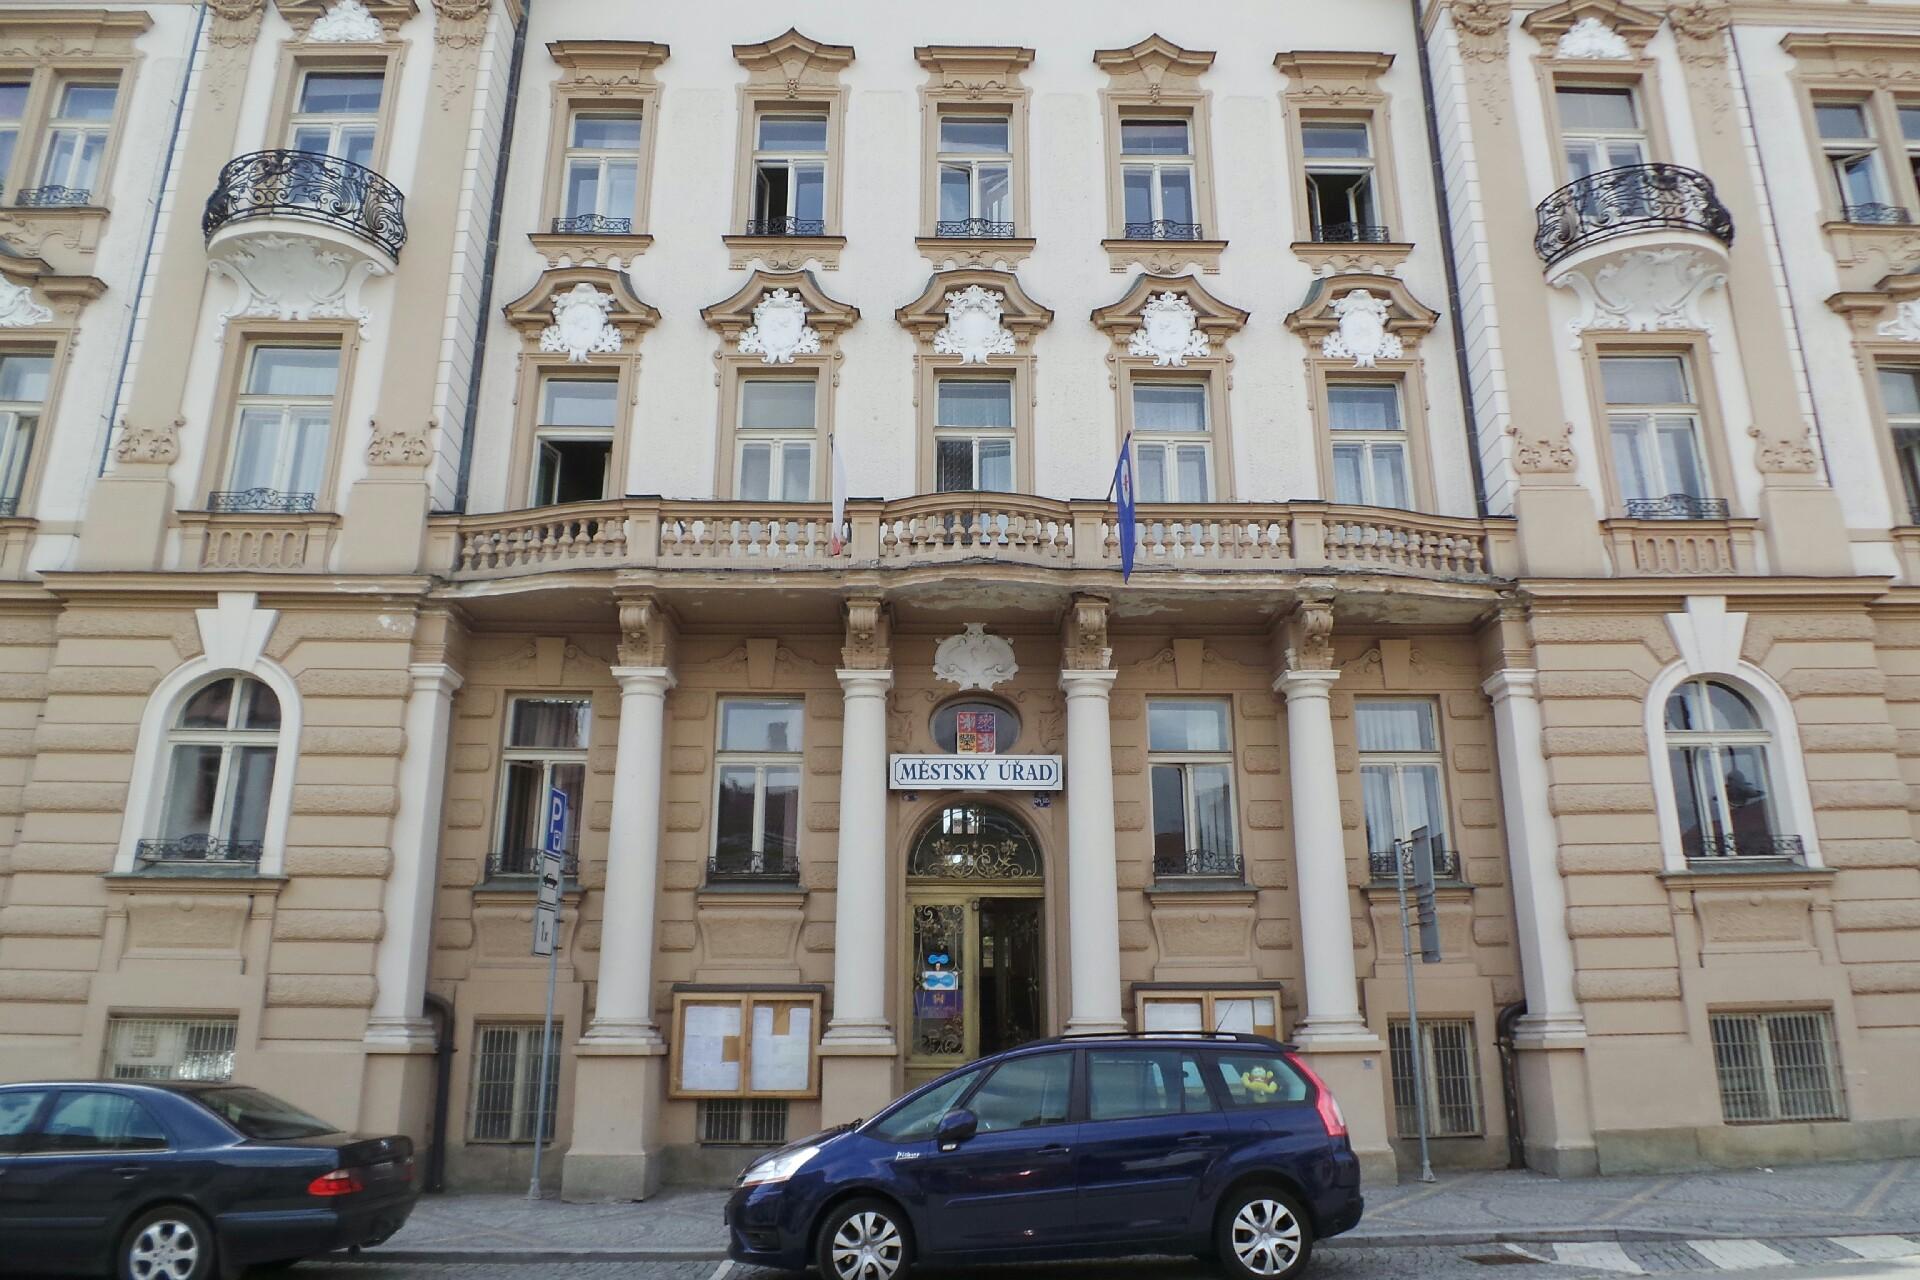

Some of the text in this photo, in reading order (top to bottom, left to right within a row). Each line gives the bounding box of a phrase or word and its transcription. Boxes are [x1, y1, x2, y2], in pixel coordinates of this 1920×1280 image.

[900, 760, 1053, 781] MĚSTSKÝ ÚŘAD
[550, 797, 563, 833] P
